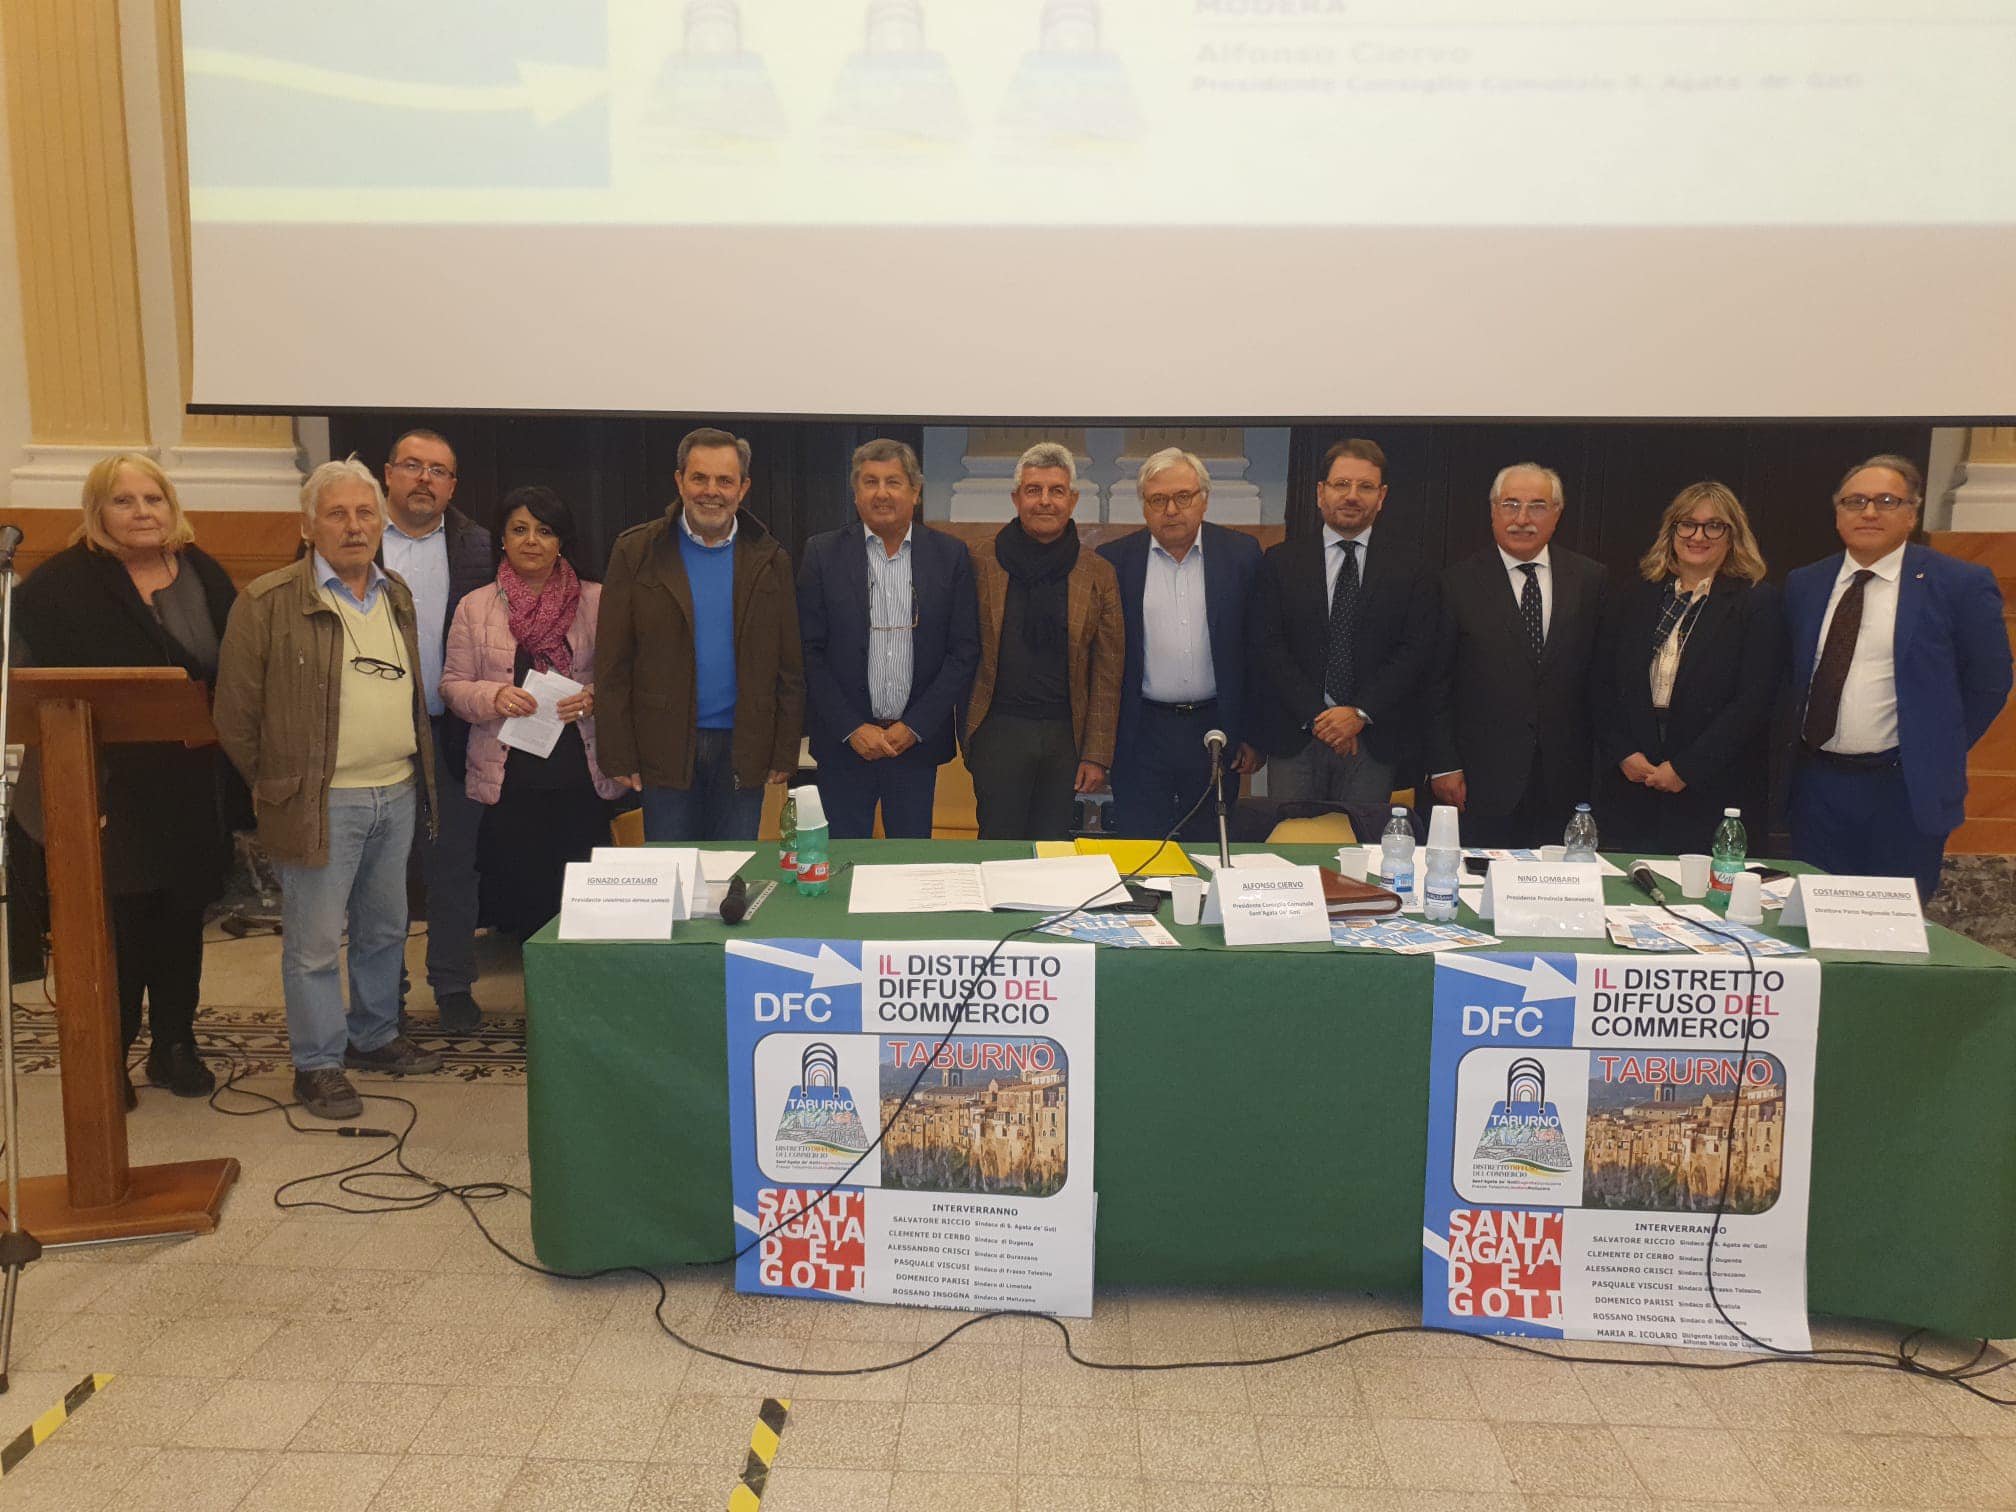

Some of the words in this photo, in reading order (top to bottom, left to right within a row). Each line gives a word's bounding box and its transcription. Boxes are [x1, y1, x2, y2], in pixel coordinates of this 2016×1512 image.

[587, 877, 619, 885] IGNAZIO
[621, 877, 658, 885] CATAURO
[1517, 875, 1537, 883] NINO
[1539, 876, 1579, 884] LOMBARDI
[1813, 888, 1864, 897] COSTANTINO
[1866, 890, 1912, 898] CATURANO
[879, 955, 901, 976] IL
[908, 955, 1061, 977] DISTRETTO
[1594, 968, 1617, 989] IL
[1625, 968, 1784, 992] DISTRETTO
[879, 979, 997, 1000] DIFFUSO
[1005, 980, 1058, 1001] DEL
[754, 992, 832, 1023] DFC
[1593, 993, 1716, 1014] DIFFUSO
[1724, 994, 1779, 1015] DEL
[879, 1002, 1049, 1025] COMMERCIO
[1462, 1005, 1543, 1037] DFC
[1591, 1017, 1770, 1039] COMMERCIO
[888, 1041, 1056, 1071] TABURNO
[1598, 1056, 1773, 1086] TABURNO
[788, 1098, 854, 1112] TABURNO
[1491, 1115, 1559, 1127] TABURNO
[758, 1188, 864, 1221] SANT'
[932, 1204, 1018, 1216] INTERVERRANNO
[893, 1216, 938, 1225] SALVATORE
[942, 1218, 971, 1226] RICCIO
[1449, 1209, 1562, 1244] SANT'
[759, 1212, 865, 1245] AGATA
[1635, 1223, 1727, 1235] INTERVERRANO
[889, 1230, 929, 1239] CLEMENTE
[944, 1233, 971, 1241] CERBO
[1593, 1236, 1641, 1244] SALVATORE
[1644, 1238, 1675, 1246] RICCIO
[888, 1244, 940, 1254] ALESSANDRO
[943, 1247, 970, 1256] CRISCI
[1449, 1236, 1561, 1267] AGATA
[1587, 1250, 1631, 1259] CLEMENTE
[1646, 1253, 1674, 1261] CERBO
[894, 1258, 935, 1268] PASQUALE
[938, 1262, 970, 1271] VISCUSI
[1585, 1265, 1641, 1274] ALESSANDRO
[1643, 1267, 1673, 1275] CRISCI
[760, 1260, 864, 1293] GOTI
[896, 1273, 939, 1283] DOMENICO
[942, 1277, 970, 1286] PARISI
[1592, 1280, 1635, 1289] PASQUALE
[1638, 1282, 1673, 1291] VISCUSI
[893, 1288, 931, 1297] ROSSANO
[933, 1291, 970, 1300] INSOGNA
[1448, 1287, 1562, 1320] GOTI
[1595, 1296, 1641, 1305] DOMENICO
[1644, 1298, 1674, 1307] PARISI
[1593, 1312, 1633, 1321] ROSSANO
[1636, 1314, 1675, 1323] INSOGNA
[1597, 1329, 1625, 1337] MARIA
[1628, 1330, 1637, 1338] R.
[1639, 1330, 1678, 1339] ICOLARO
